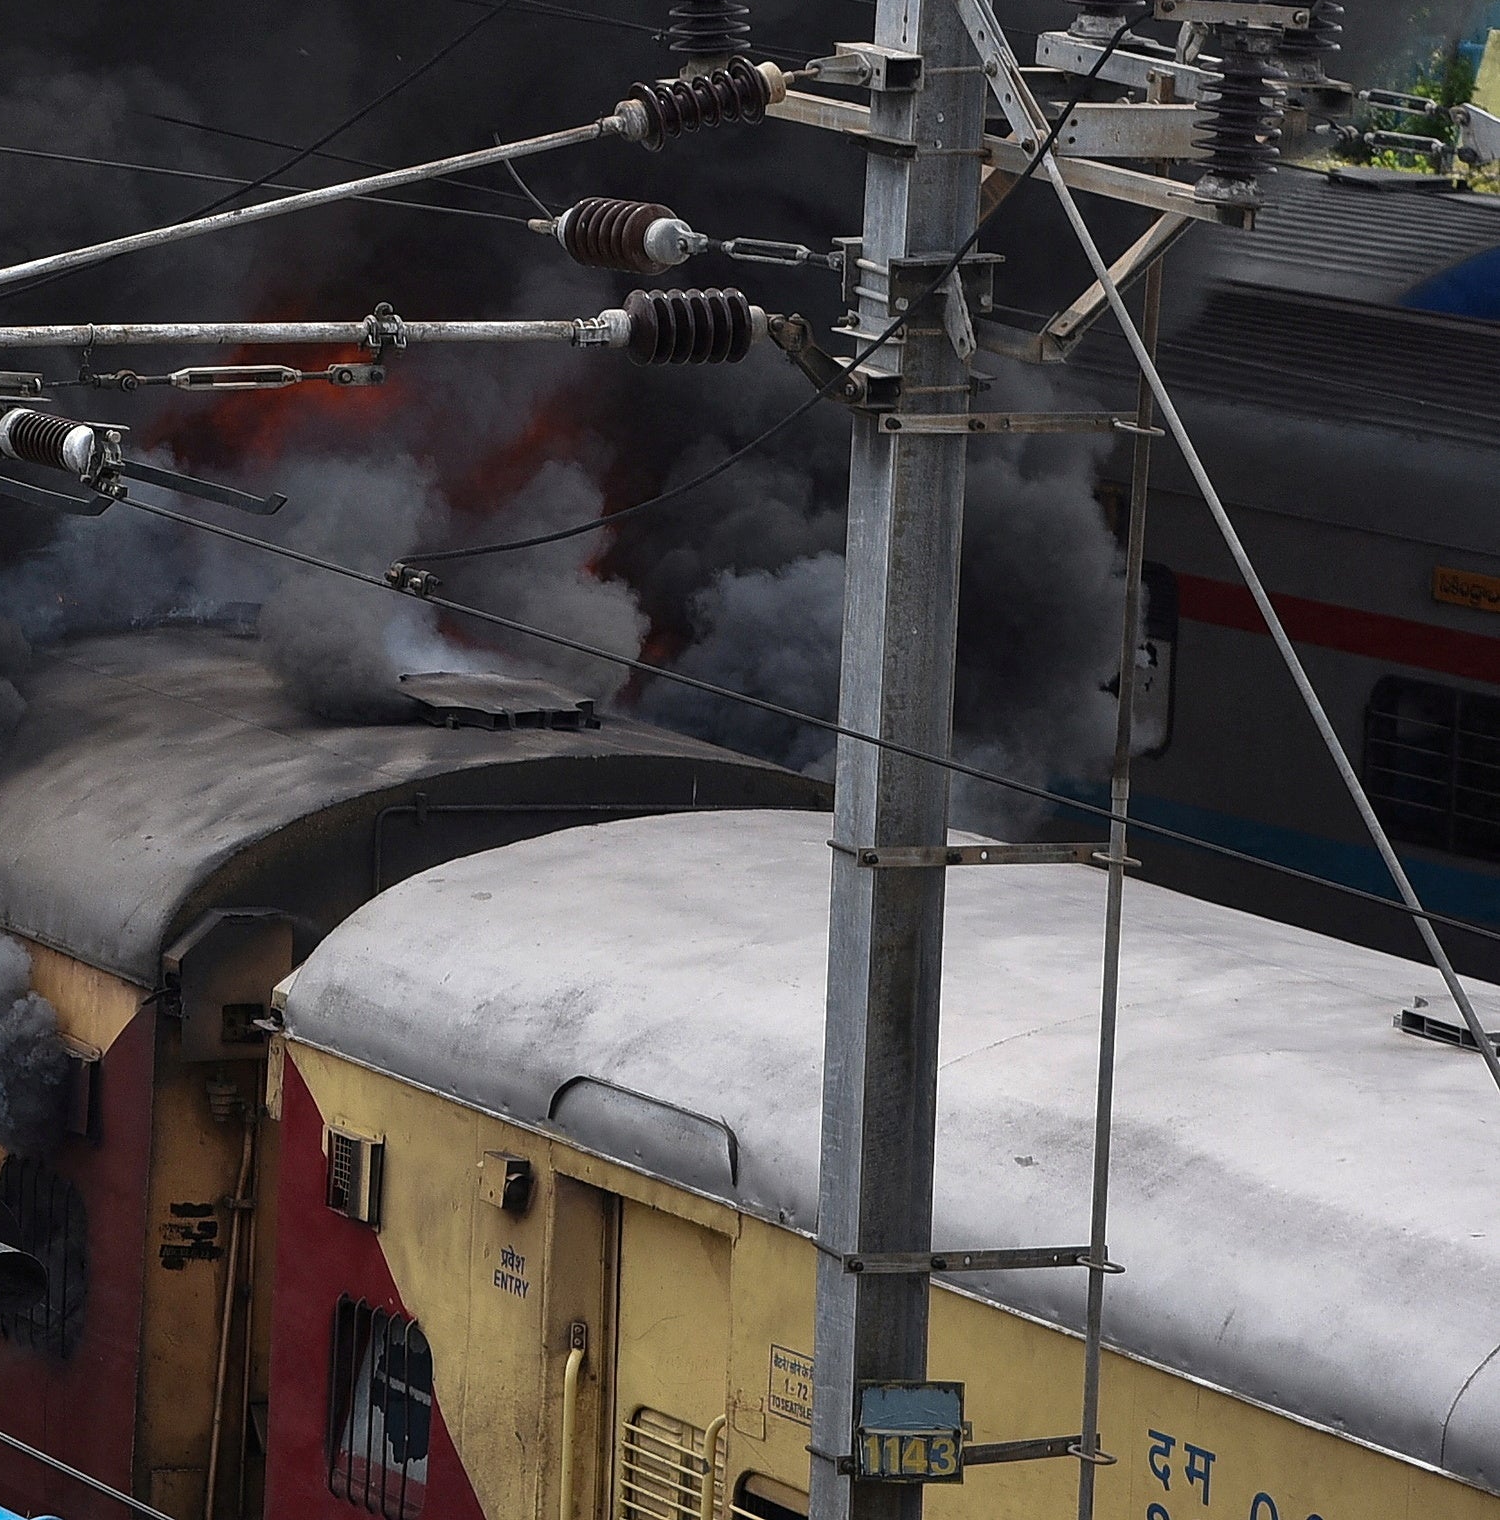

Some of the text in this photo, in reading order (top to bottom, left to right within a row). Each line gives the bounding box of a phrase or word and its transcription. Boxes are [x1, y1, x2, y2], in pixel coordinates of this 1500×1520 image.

[500, 1244, 526, 1276] प्रवेश
[493, 1268, 530, 1299] ENTRY
[864, 1433, 957, 1475] 1143
